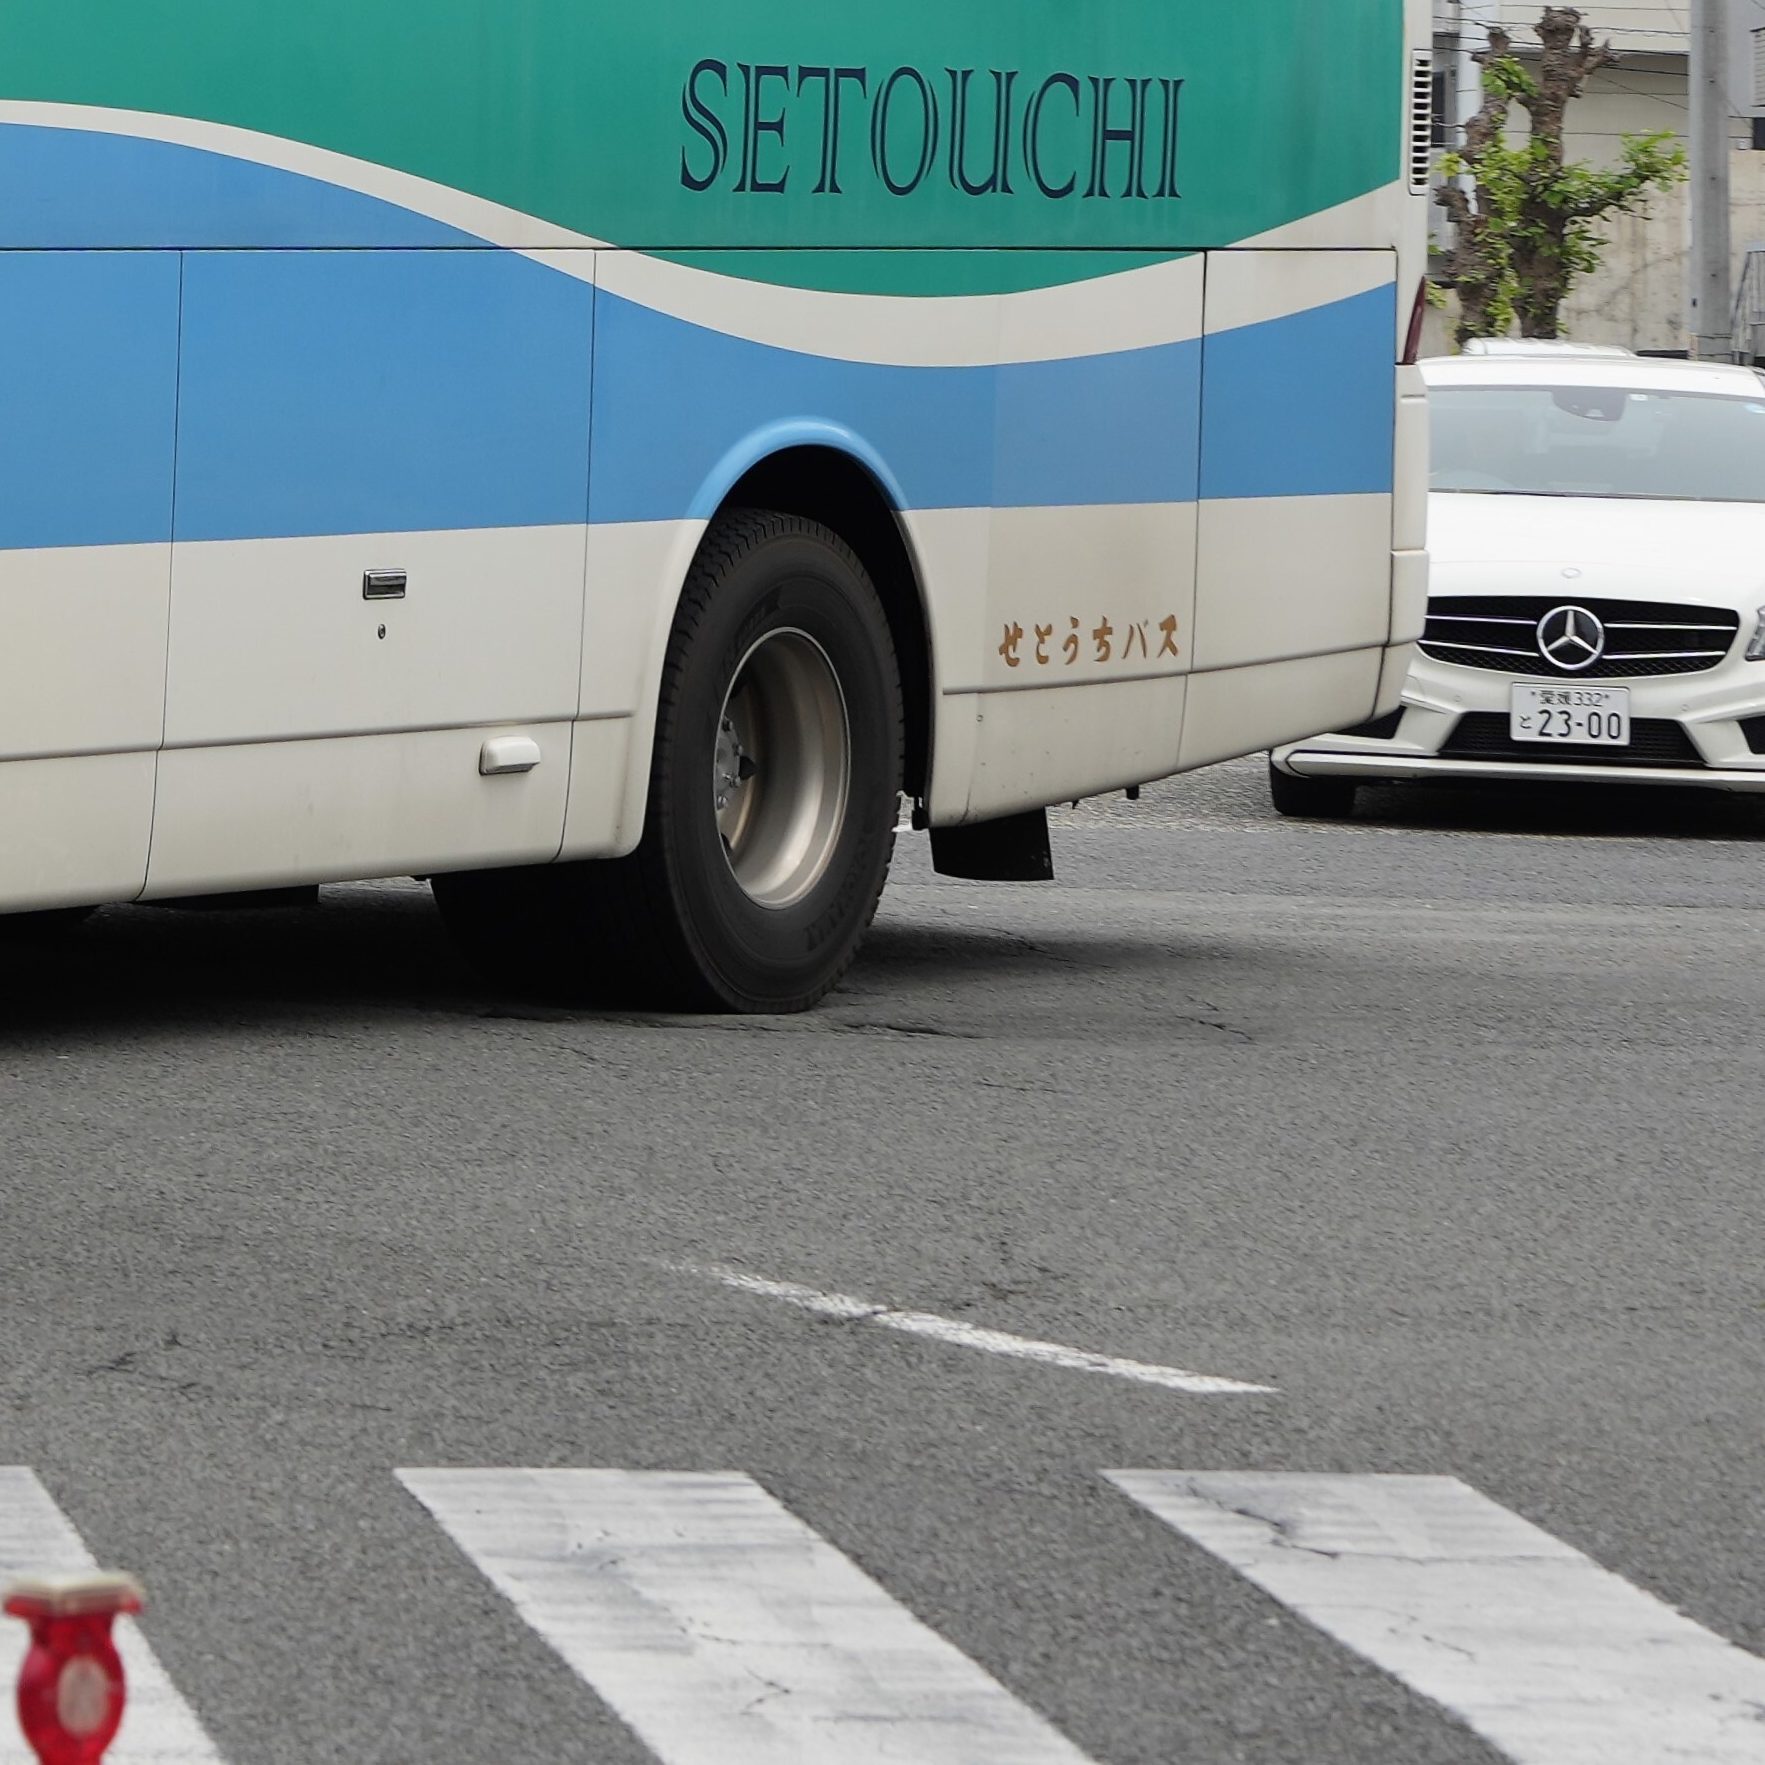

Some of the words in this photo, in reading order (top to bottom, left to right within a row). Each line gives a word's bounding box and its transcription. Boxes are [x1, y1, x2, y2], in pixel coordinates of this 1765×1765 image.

[680, 57, 1185, 200] SETOUCHI
[997, 613, 1179, 668] せとうちバス
[1518, 714, 1533, 729] と
[1537, 709, 1621, 740] 23-00
